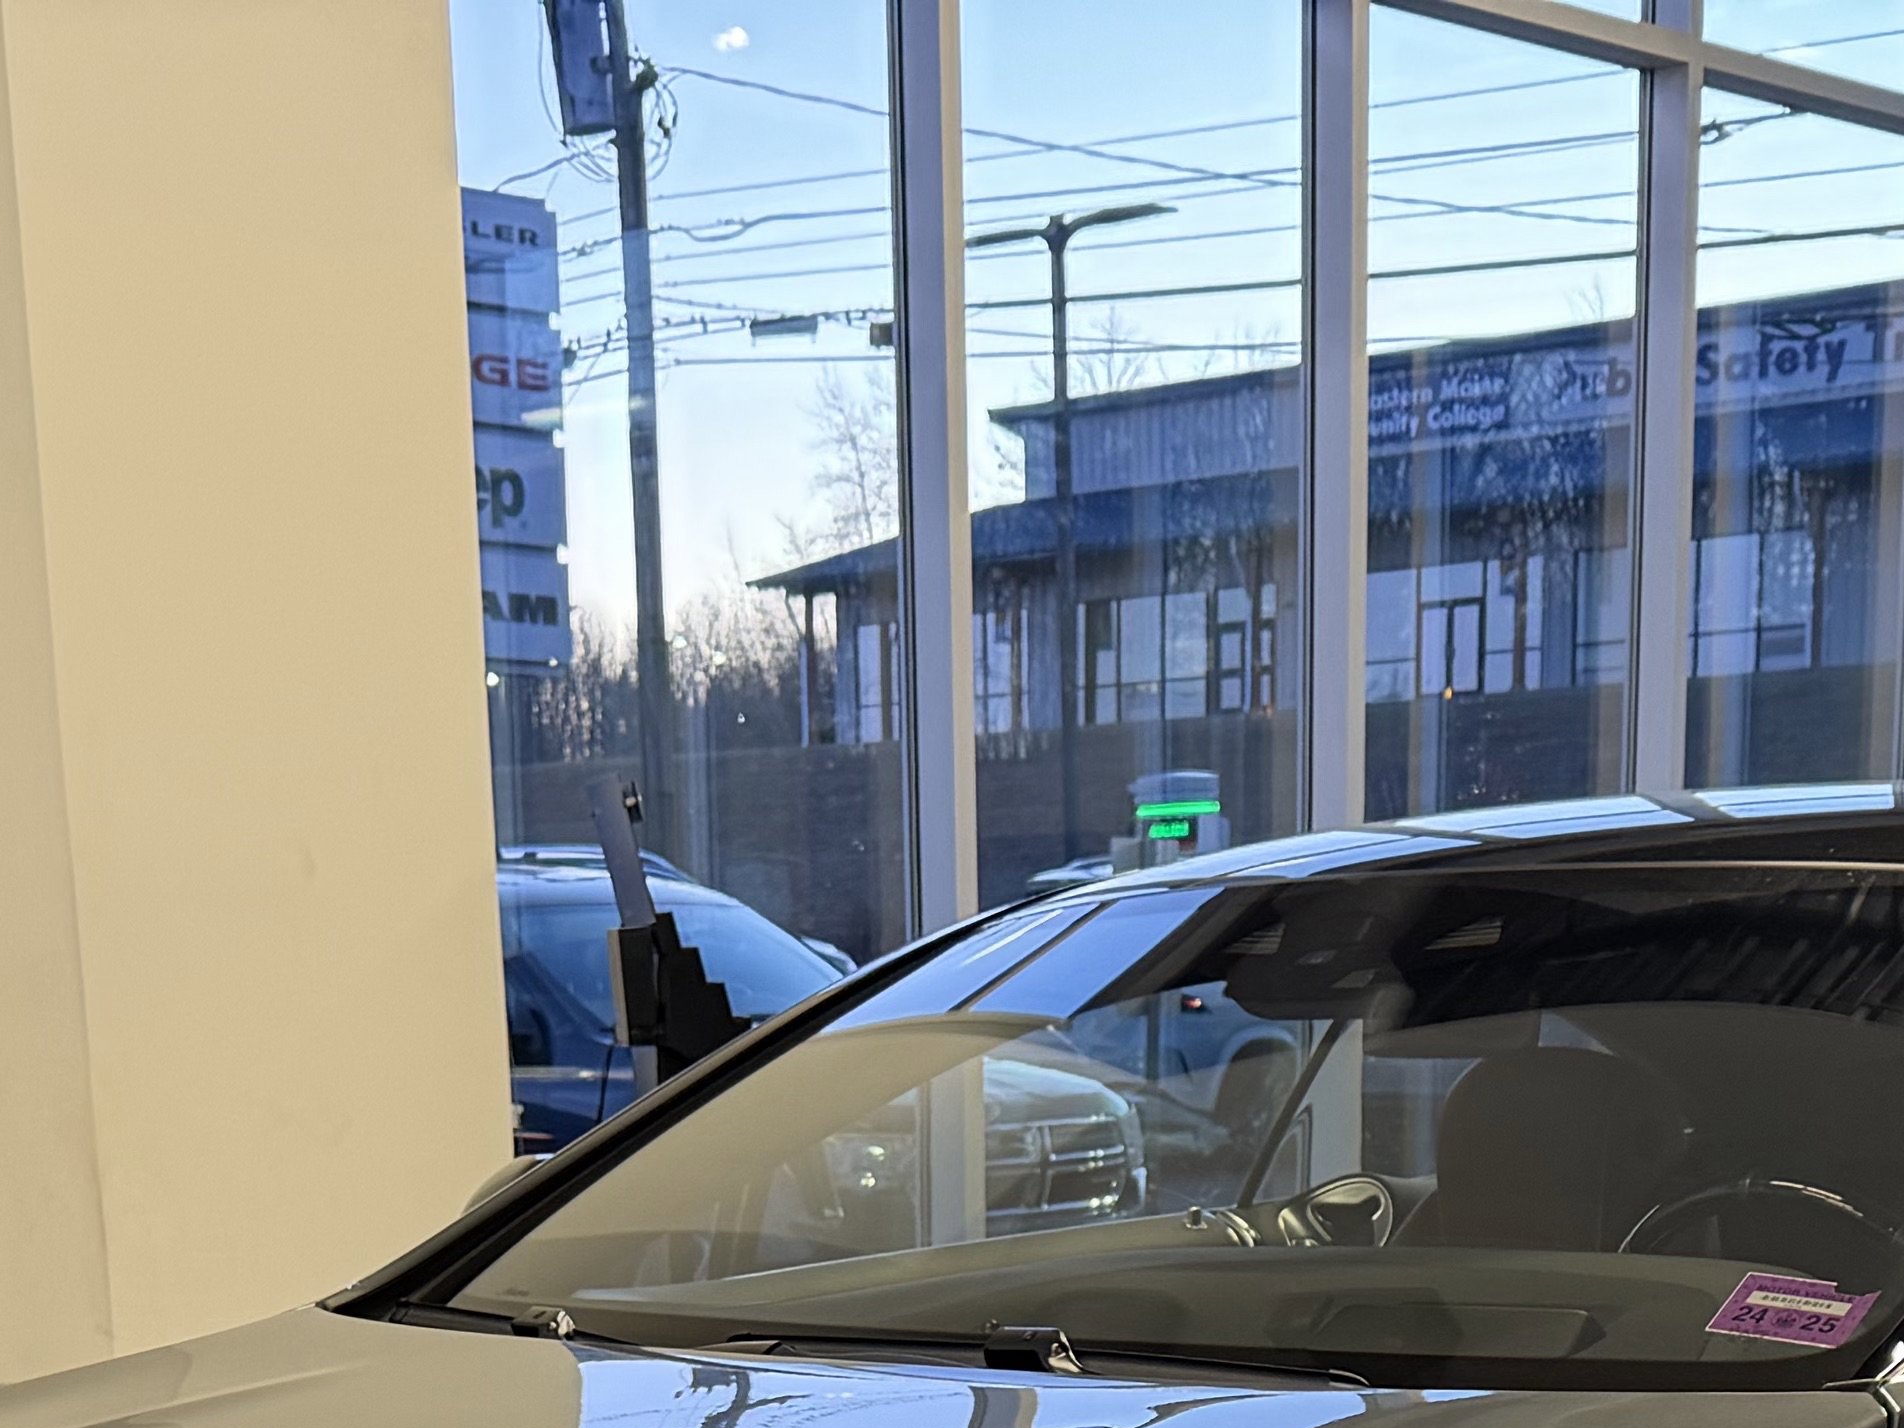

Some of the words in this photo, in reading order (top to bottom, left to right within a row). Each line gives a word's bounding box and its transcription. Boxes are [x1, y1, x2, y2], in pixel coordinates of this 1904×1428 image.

[1696, 331, 1847, 385] Safety
[1731, 1305, 1769, 1324] 24
[1799, 1314, 1841, 1333] 25
